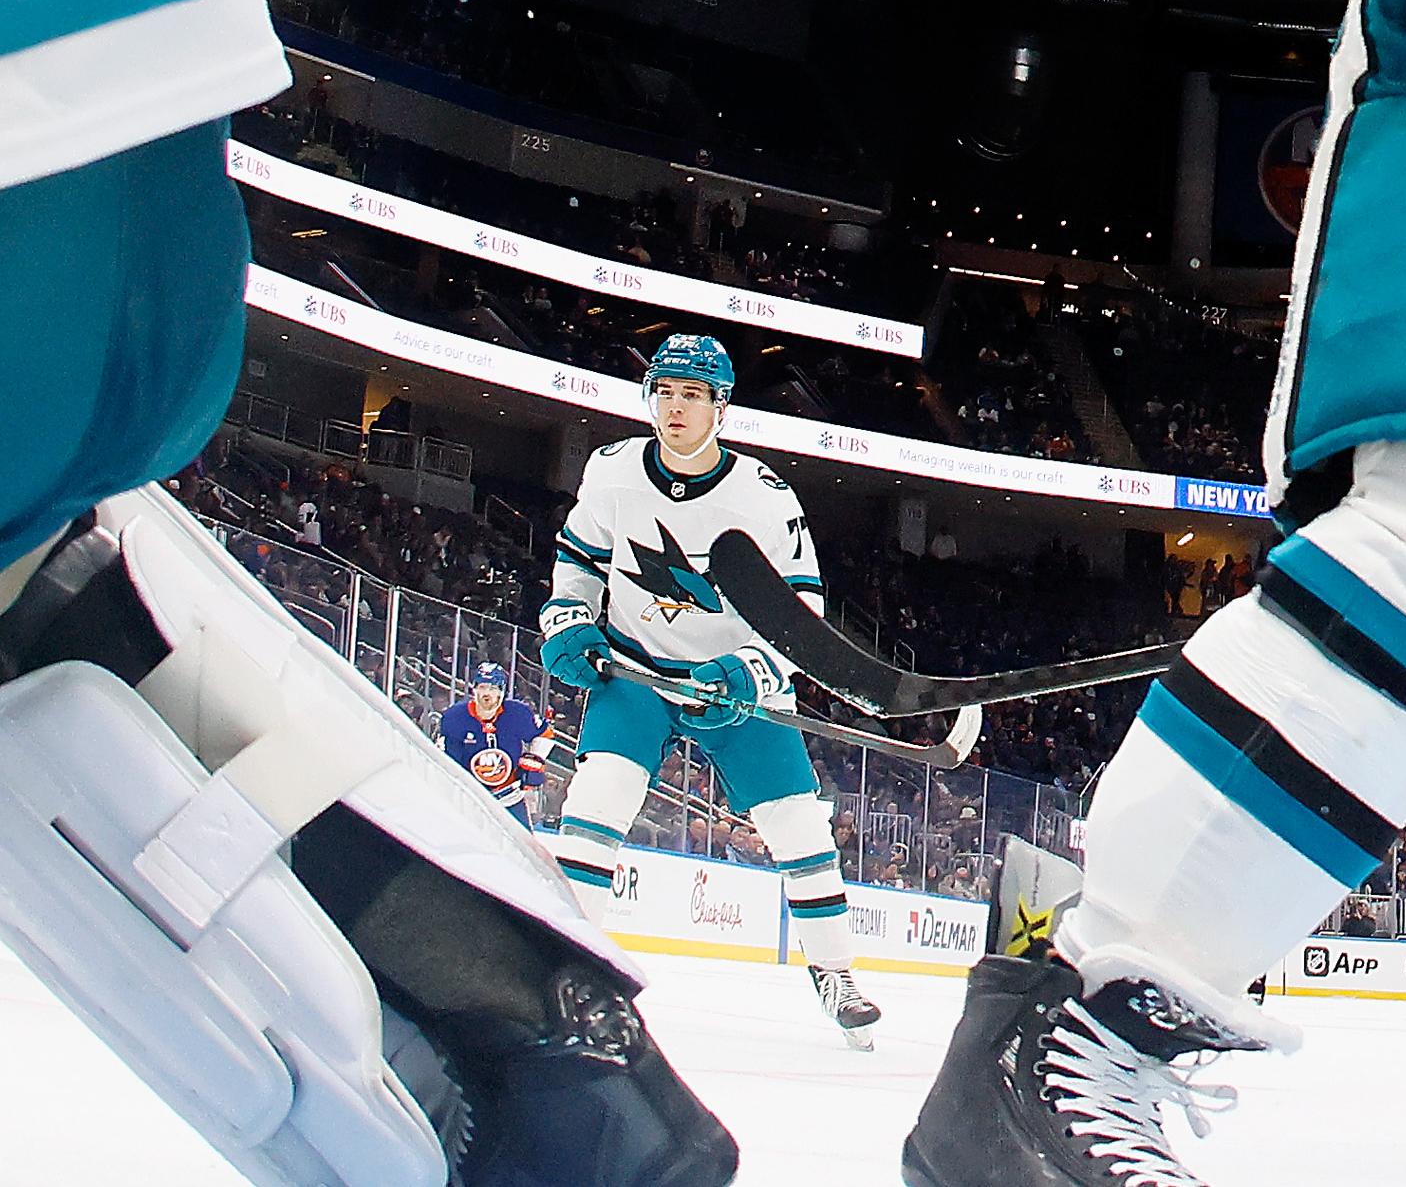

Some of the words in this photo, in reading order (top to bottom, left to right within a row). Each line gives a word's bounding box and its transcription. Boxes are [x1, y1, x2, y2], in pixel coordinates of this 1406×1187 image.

[521, 133, 551, 152] 225
[246, 158, 271, 180] UBS
[367, 197, 397, 220] UBS
[491, 235, 520, 257] UBS
[612, 271, 643, 290] UBS
[319, 302, 347, 325] UBS
[746, 300, 776, 318] UBS
[874, 326, 904, 344] UBS
[570, 378, 600, 398] UBS
[838, 435, 870, 455] UBS
[899, 448, 955, 472] Managing
[958, 458, 995, 476] wealth
[1012, 470, 1033, 482] our
[1118, 477, 1152, 496] UBS
[1188, 484, 1238, 510] NEW
[921, 907, 977, 952] DELMAR
